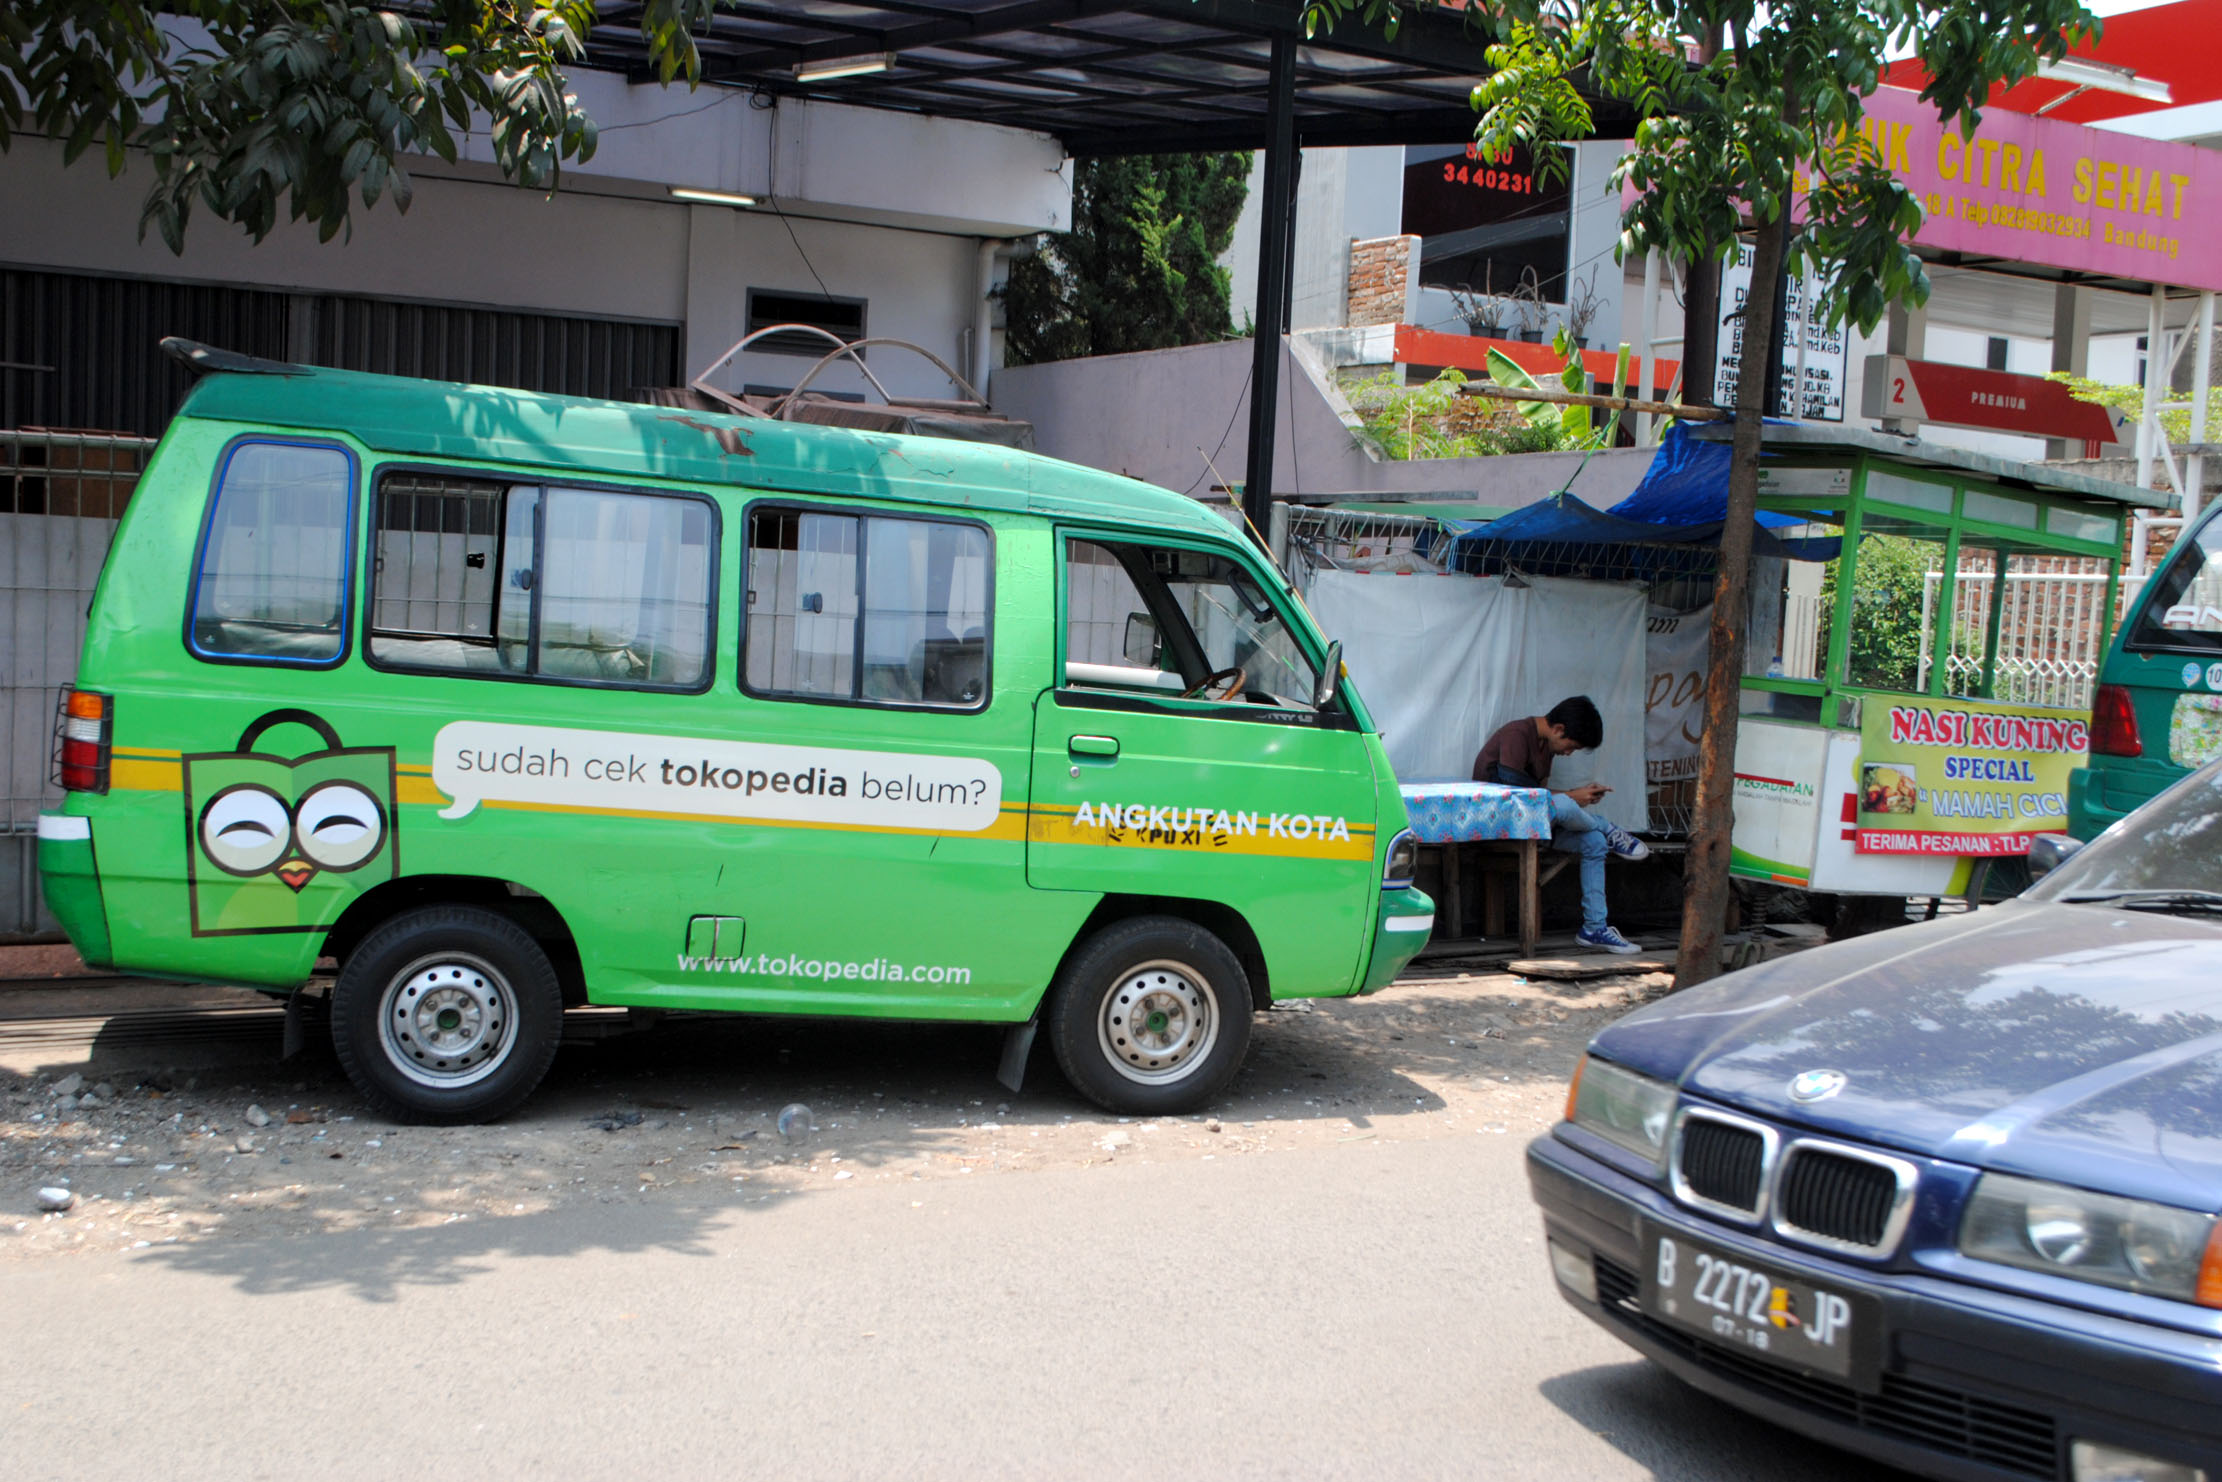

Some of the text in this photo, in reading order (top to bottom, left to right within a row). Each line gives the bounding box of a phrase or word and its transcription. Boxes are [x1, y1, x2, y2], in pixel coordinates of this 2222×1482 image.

[1443, 162, 1532, 195] 3440231
[1937, 132, 2046, 198] CITRA
[2072, 157, 2190, 221] SEHAT
[1945, 196, 1955, 218] A
[1961, 197, 1989, 229] Telp
[2104, 222, 2180, 260] Bandung
[1892, 378, 2027, 410] 2 PREMIUM
[1889, 707, 2089, 753] NASI KUNING
[456, 746, 988, 804] sudah cek tokopedia belum?
[1944, 756, 2034, 783] SPECIAL
[1072, 801, 1351, 842] ANGKUTAN KOTA
[1862, 832, 1917, 850] TERIMA
[1921, 836, 1991, 852] PESANAN
[2003, 836, 2030, 852] TLP
[676, 953, 972, 986] www.tokopedia.com
[1657, 1237, 1851, 1346] B 2272 JP
